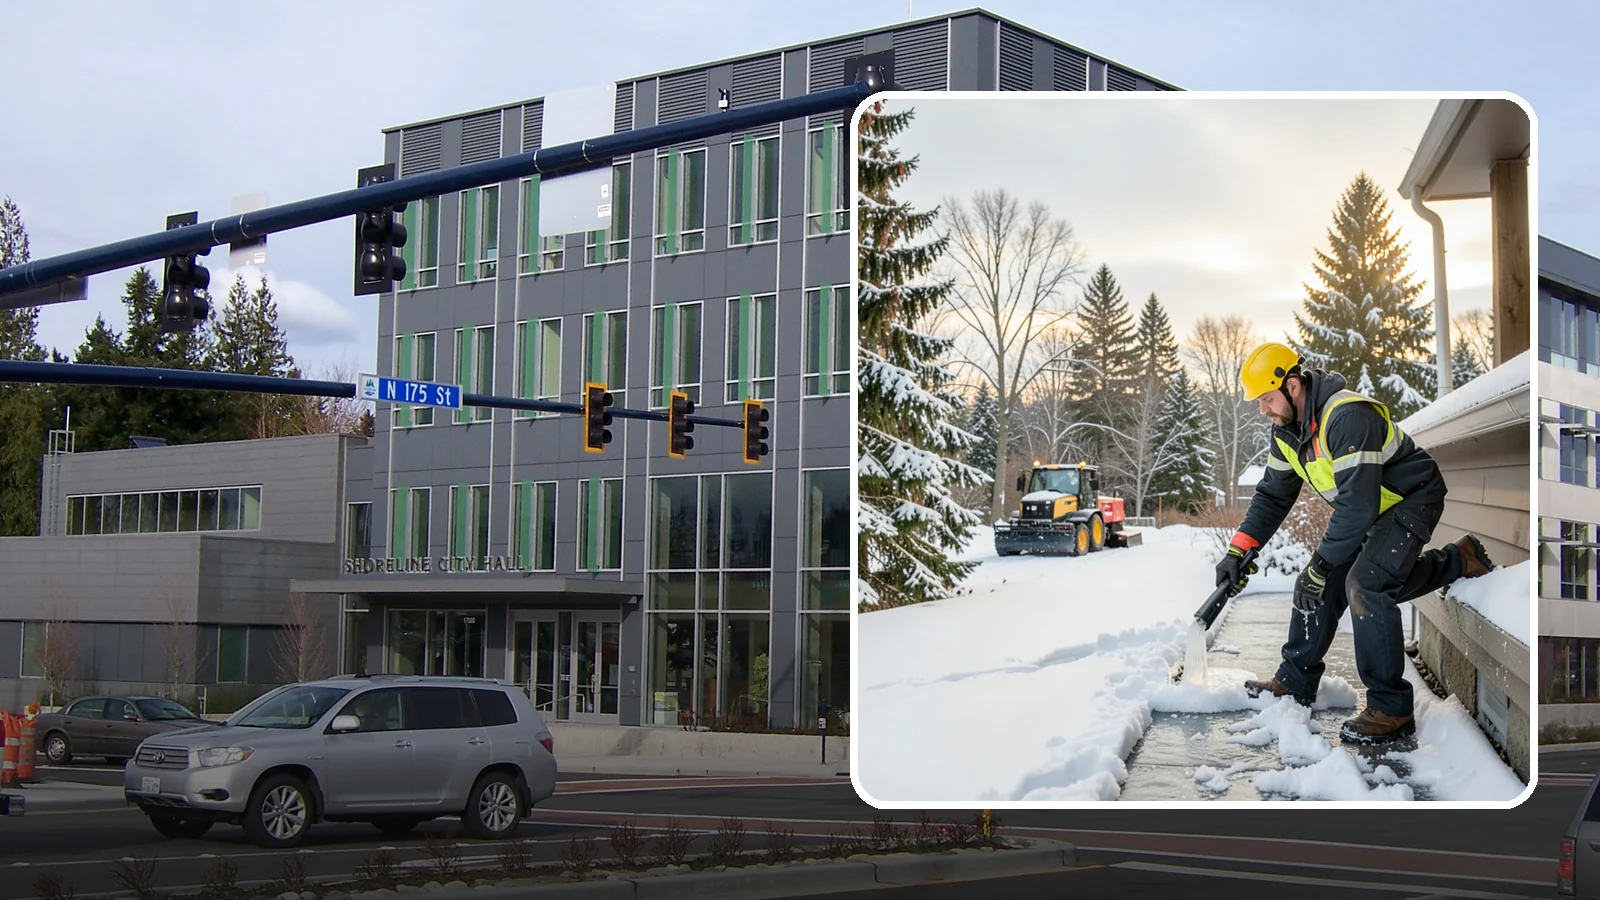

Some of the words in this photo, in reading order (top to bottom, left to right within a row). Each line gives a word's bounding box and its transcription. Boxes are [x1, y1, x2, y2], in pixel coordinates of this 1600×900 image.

[387, 380, 397, 399] N
[405, 382, 427, 403] 175
[436, 386, 452, 405] St
[344, 556, 432, 574] SHORELINE
[438, 556, 475, 573] CITY
[483, 555, 525, 572] HALL
